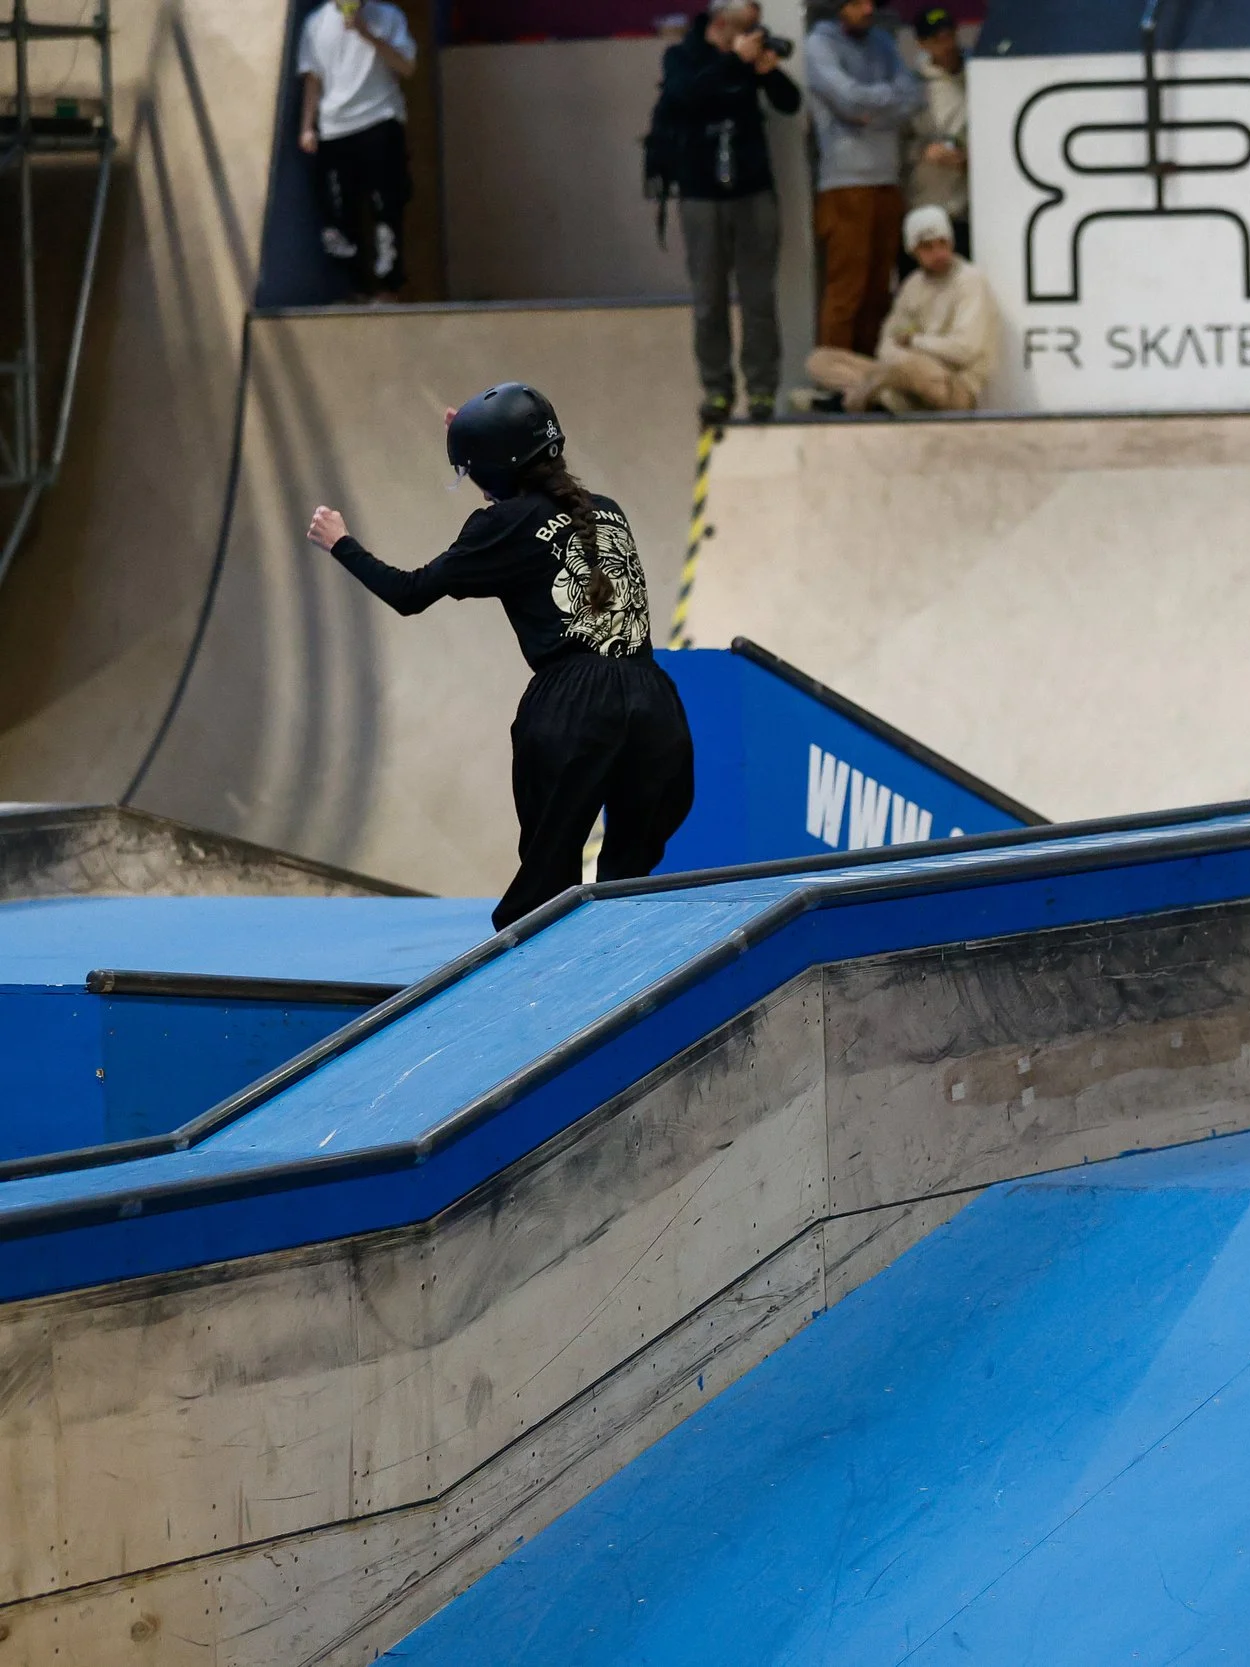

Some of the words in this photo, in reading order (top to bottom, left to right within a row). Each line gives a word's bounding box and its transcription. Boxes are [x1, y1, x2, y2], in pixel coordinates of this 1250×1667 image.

[1023, 325, 1083, 370] FR
[535, 512, 573, 543] BAD
[806, 743, 964, 850] WWW
